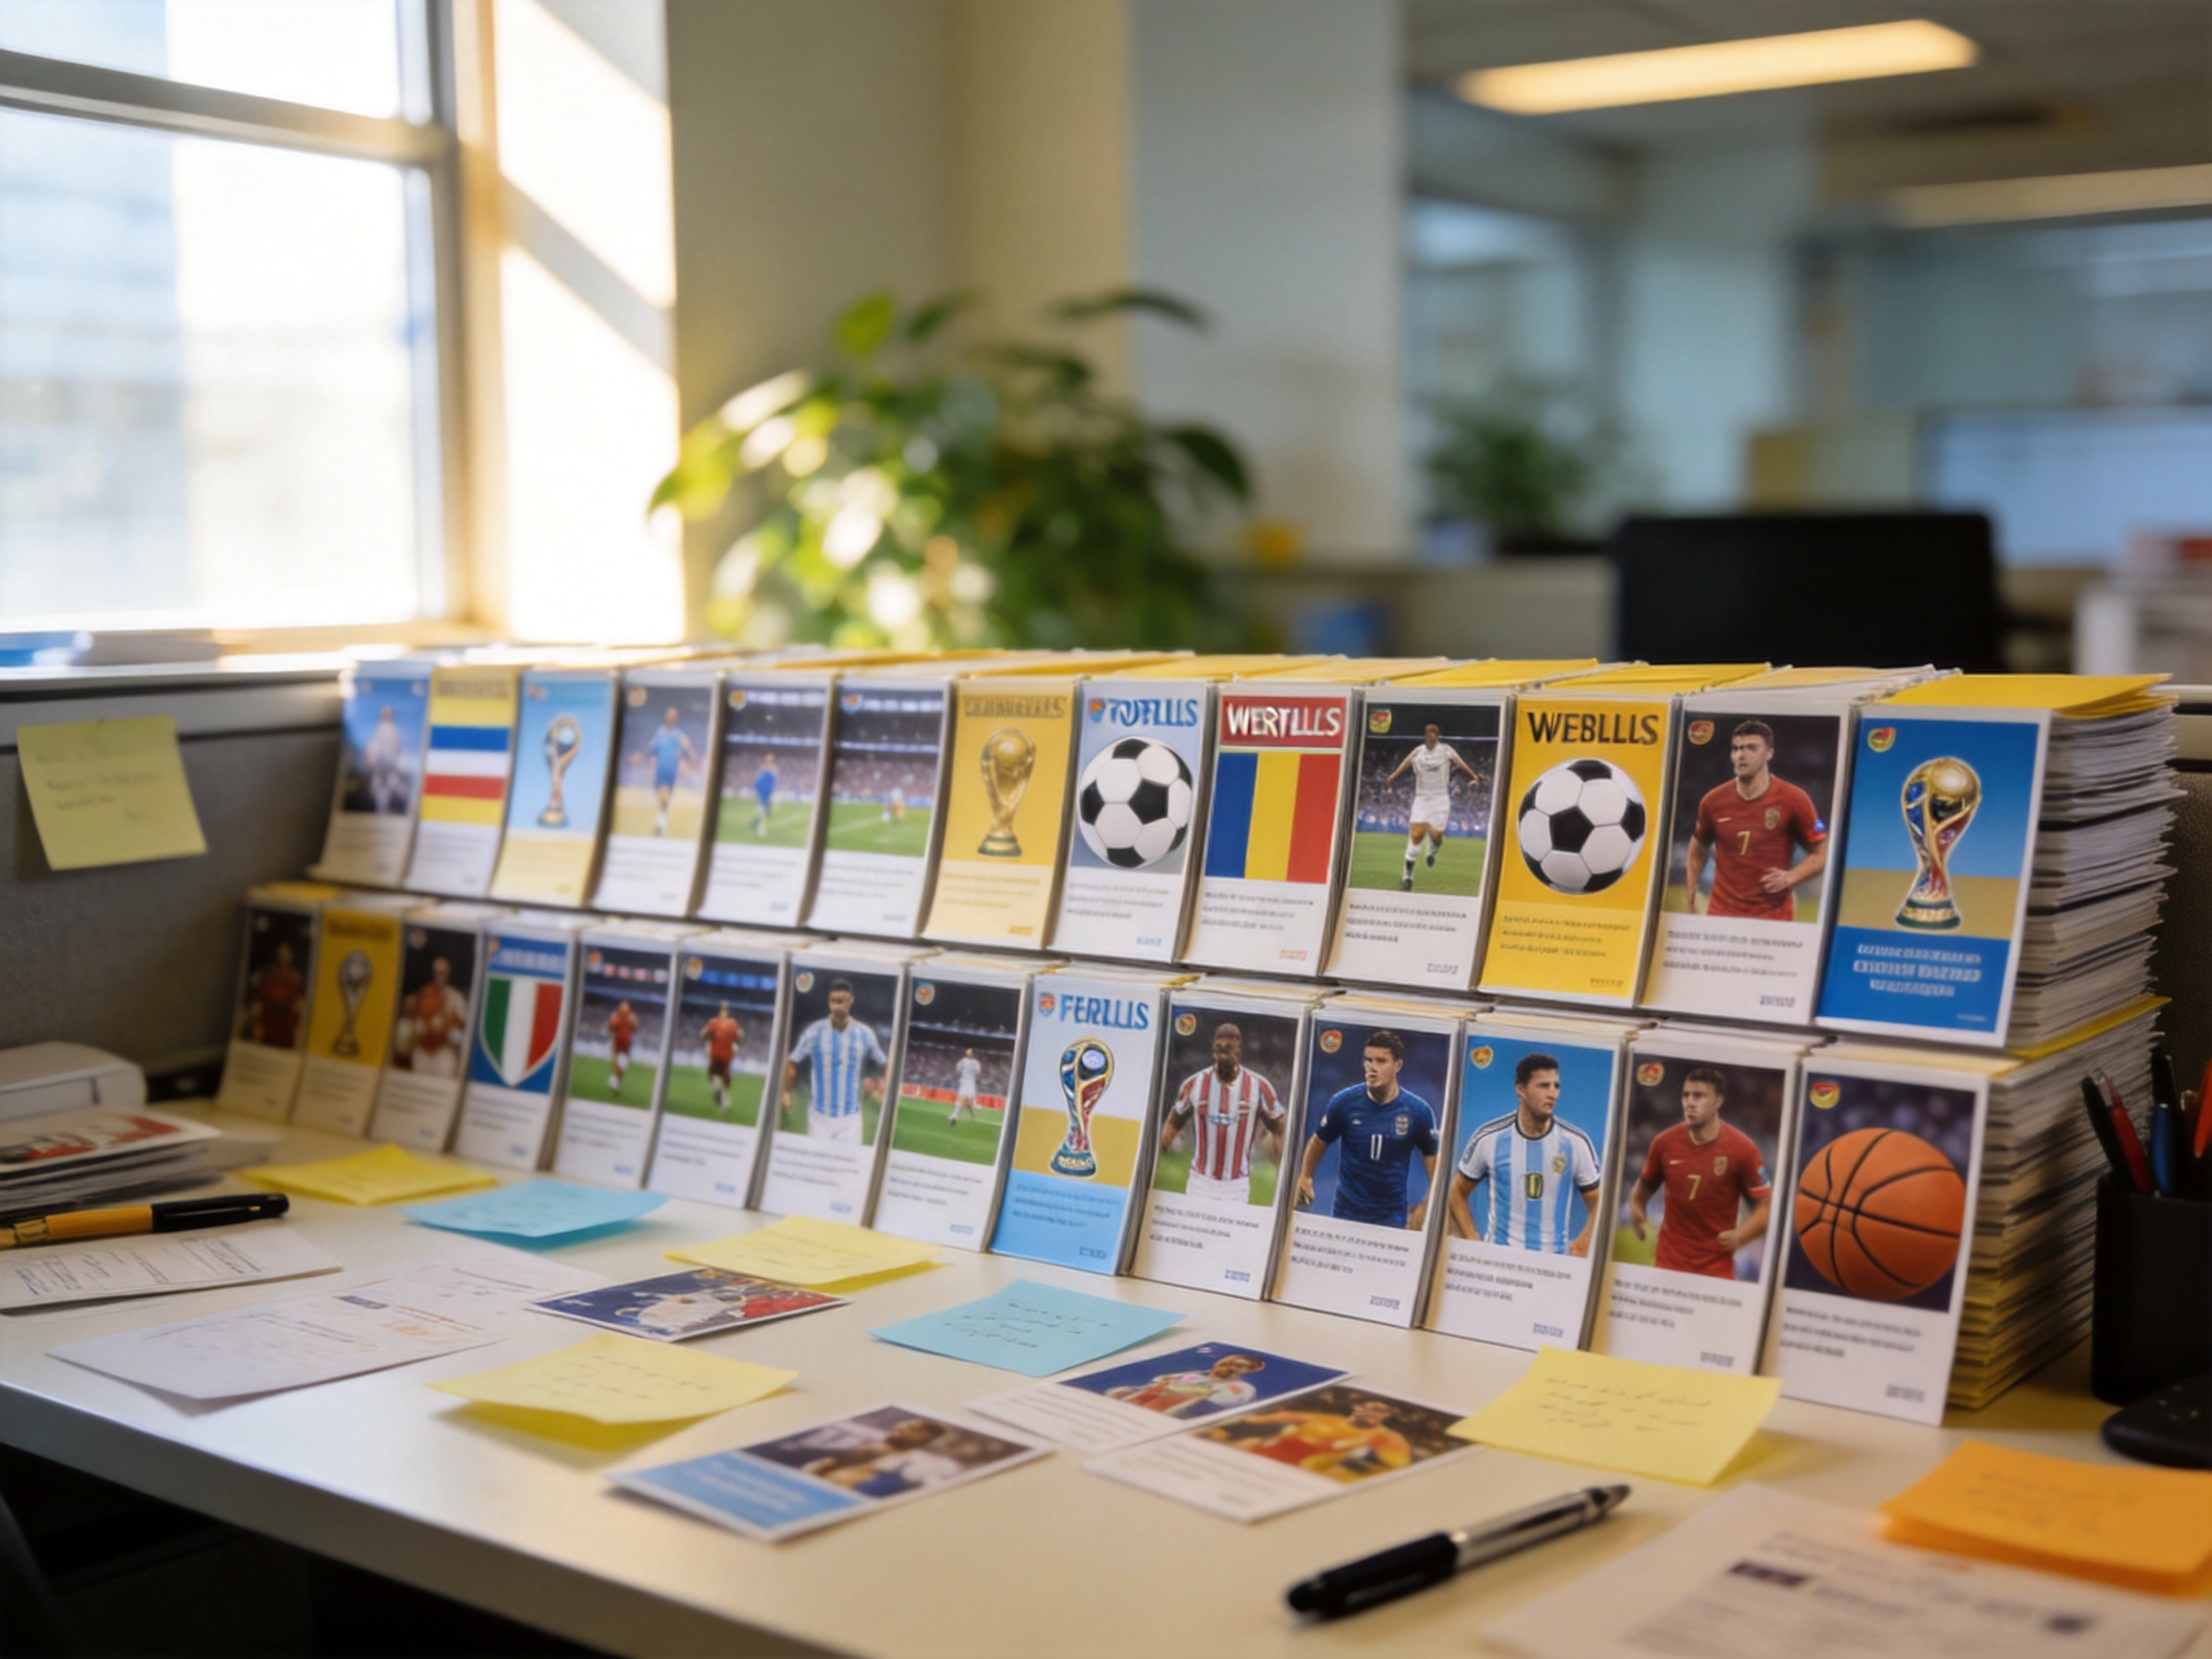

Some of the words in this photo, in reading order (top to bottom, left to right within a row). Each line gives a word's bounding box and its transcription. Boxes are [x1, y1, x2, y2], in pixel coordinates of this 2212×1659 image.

[1527, 711, 1659, 745] WEBLLLS
[1737, 830, 1751, 855] 7
[1687, 1174, 1701, 1200] 7
